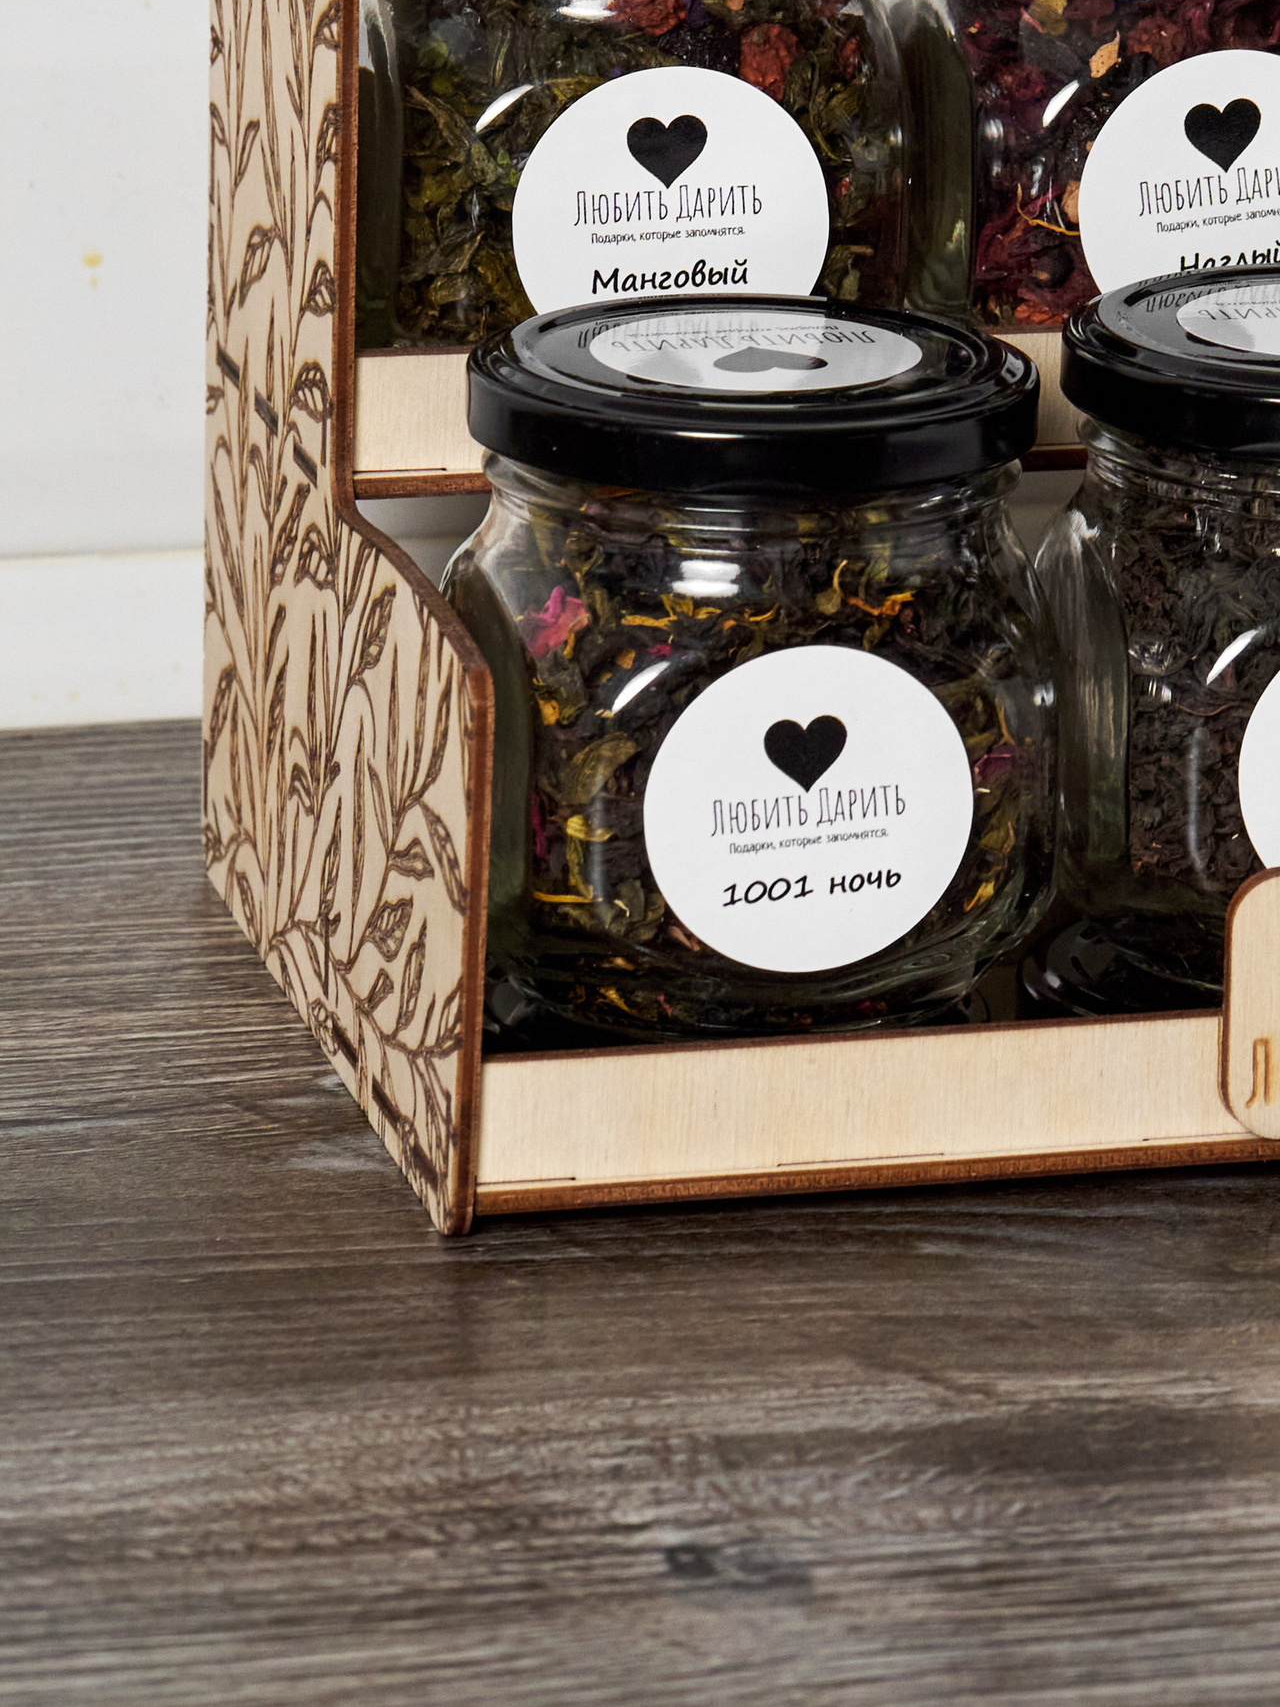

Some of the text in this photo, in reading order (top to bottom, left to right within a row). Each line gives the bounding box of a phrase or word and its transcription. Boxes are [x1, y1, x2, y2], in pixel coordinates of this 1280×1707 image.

[573, 184, 763, 227] ЛЮБИТЬ ДАРИТЬ
[1139, 174, 1228, 217] ЛЮБИТЬ
[639, 230, 682, 243] которые
[1202, 213, 1243, 227] которые
[591, 258, 749, 295] Манговый
[711, 784, 906, 837] ЛЮБИТЬ ДАРИТЬ
[779, 835, 822, 849] которые
[722, 868, 902, 908] 1001 ночь
